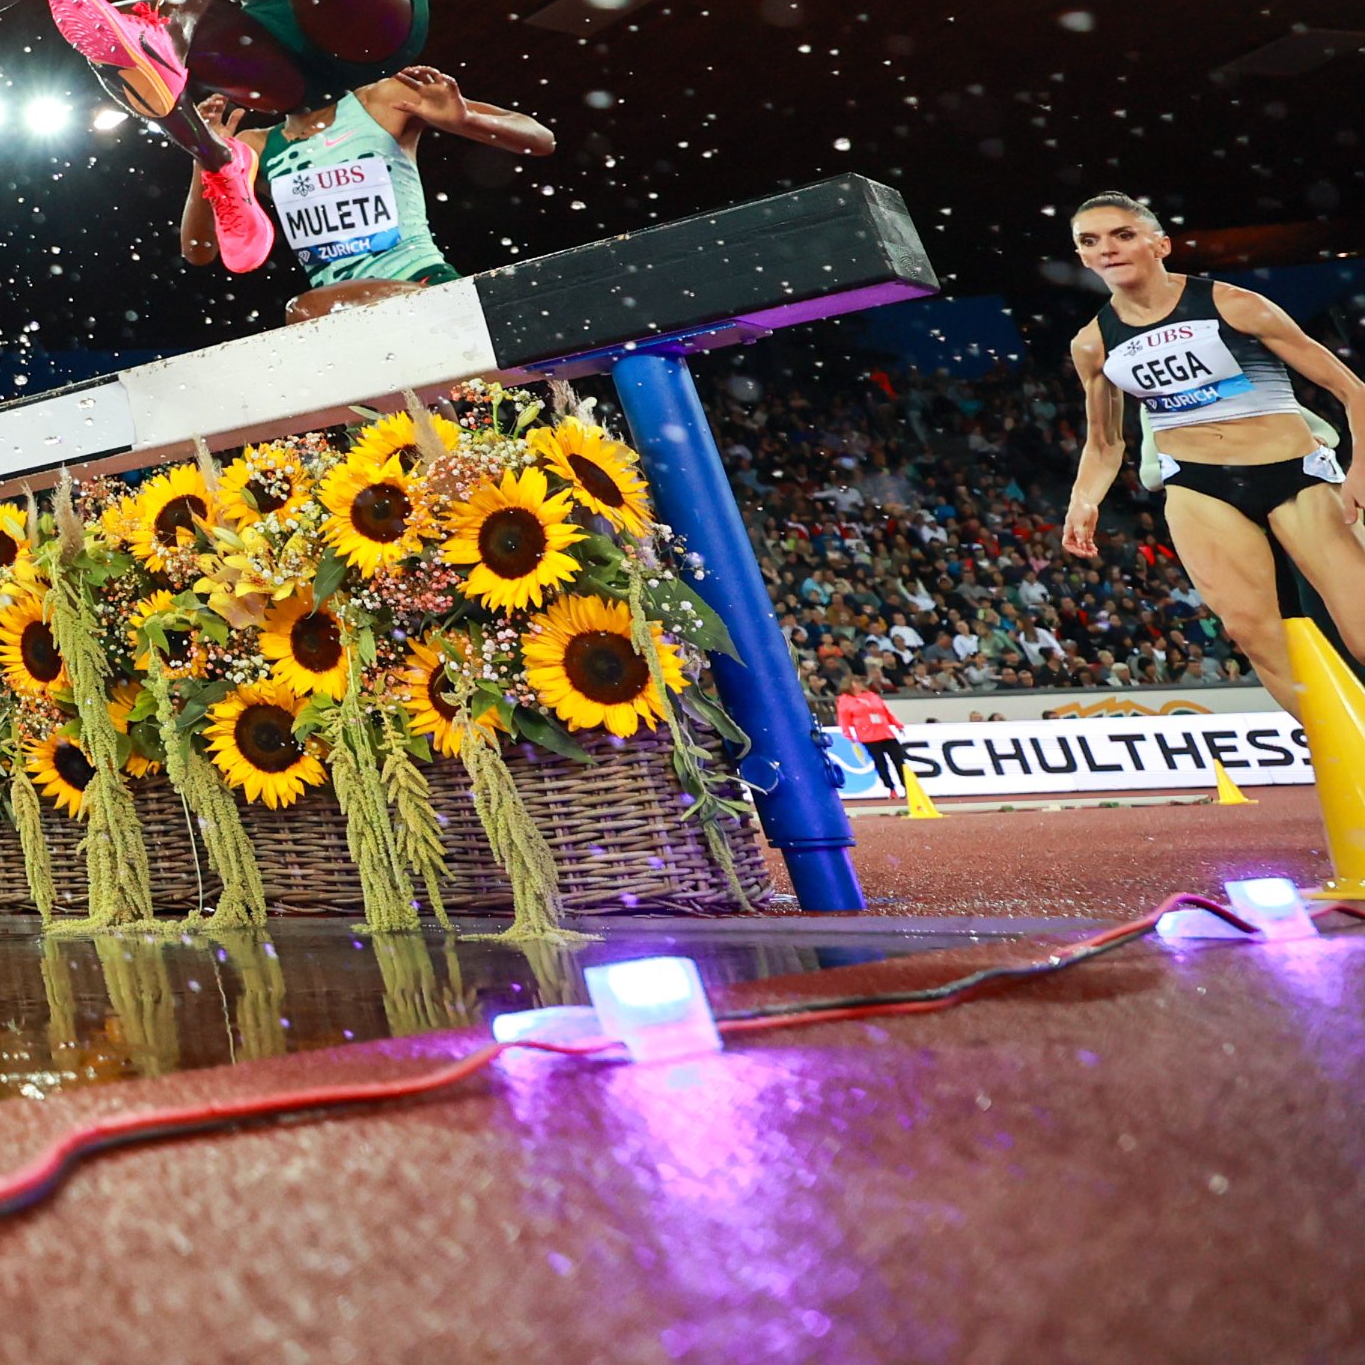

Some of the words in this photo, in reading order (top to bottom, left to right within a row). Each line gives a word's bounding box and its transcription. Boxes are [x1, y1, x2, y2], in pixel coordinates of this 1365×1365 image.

[317, 165, 365, 189] UBS
[286, 195, 391, 240] MULETA
[318, 238, 371, 259] ZURICH
[1146, 325, 1194, 347] UBS
[1131, 351, 1213, 390] GEGA
[1162, 387, 1219, 409] ZURICH
